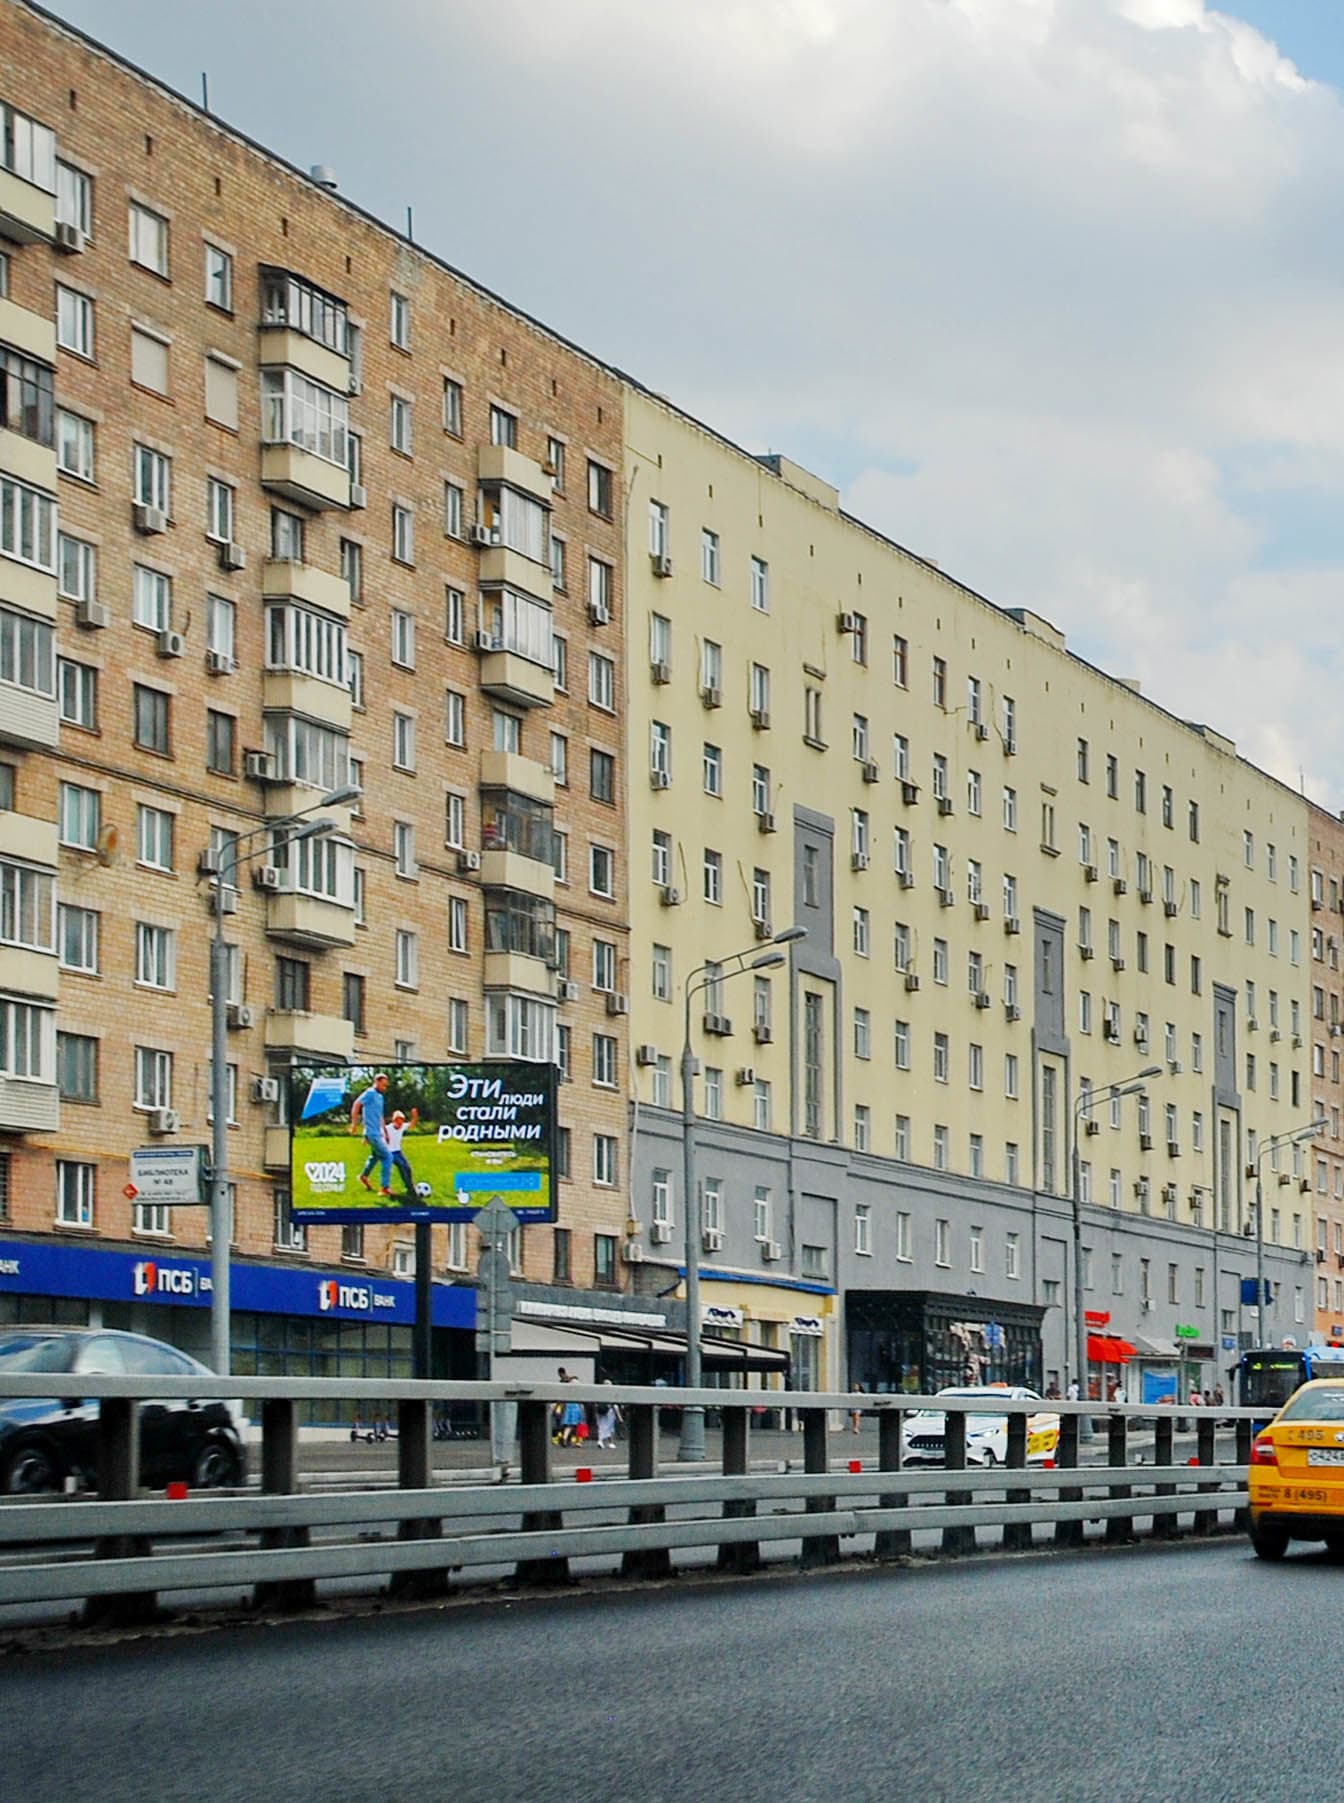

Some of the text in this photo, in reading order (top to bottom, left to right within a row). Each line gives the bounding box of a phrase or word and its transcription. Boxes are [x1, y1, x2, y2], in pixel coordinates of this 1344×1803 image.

[447, 1074, 544, 1107] Эти люди
[456, 1106, 517, 1120] стали
[437, 1124, 541, 1144] родными
[157, 1268, 193, 1294] ПСБ
[339, 1285, 396, 1310] ПСБ БАНК
